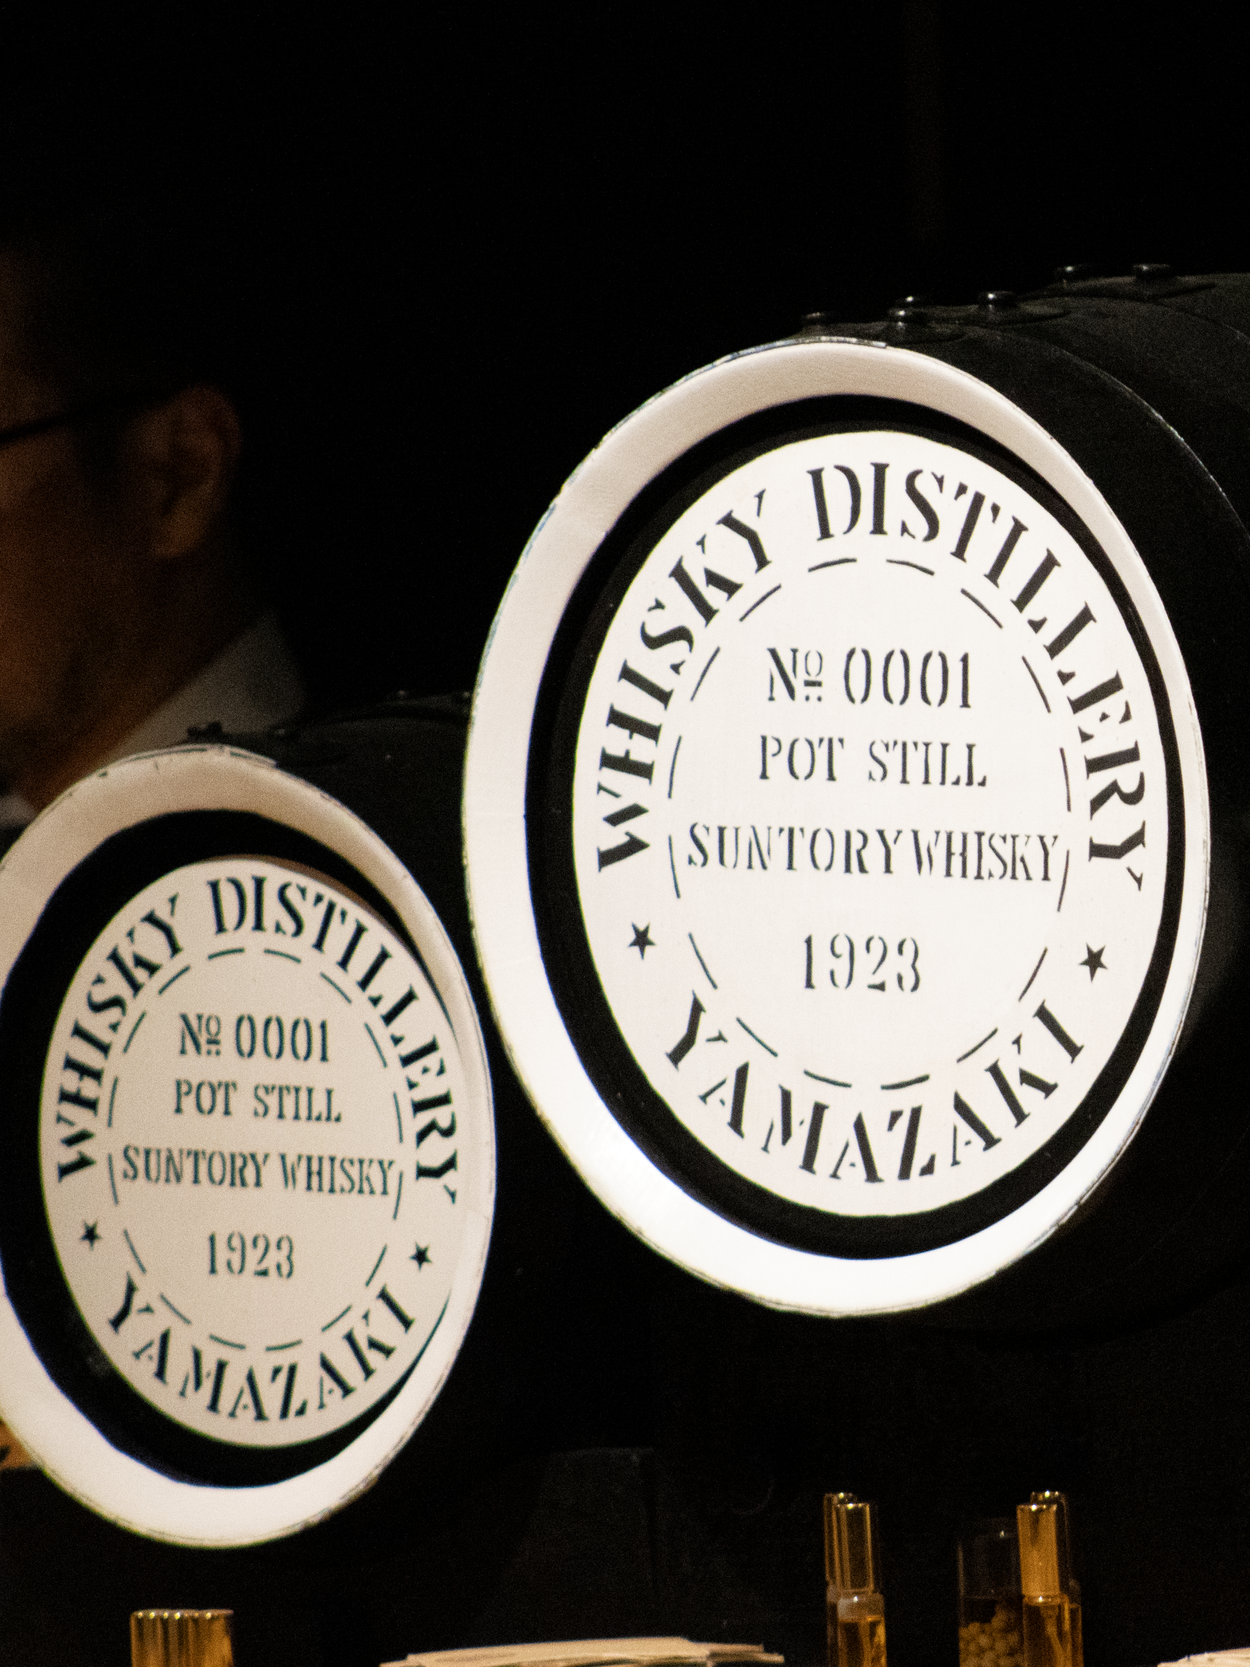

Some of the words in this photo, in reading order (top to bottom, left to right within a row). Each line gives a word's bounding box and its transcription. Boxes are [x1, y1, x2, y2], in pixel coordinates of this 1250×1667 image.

[595, 488, 773, 873] WHISKY
[805, 462, 1147, 891] DISTILLERY
[843, 647, 971, 709] 0001
[759, 735, 844, 782] POT
[868, 739, 987, 788] STILL
[687, 822, 903, 874] SUNTORY
[911, 829, 1058, 882] WHISKY
[804, 934, 921, 993] 1923
[57, 893, 185, 1182] WHISKY
[205, 876, 457, 1205] DISTILLERY
[234, 1014, 329, 1063] 0001
[173, 1079, 237, 1117] POT
[253, 1084, 342, 1123] STILL
[665, 990, 1085, 1184] YAMAZAKI
[122, 1144, 270, 1188] SUNTORY
[278, 1152, 395, 1196] WHISKY
[208, 1232, 294, 1279] 1923
[107, 1270, 417, 1422] YAMAZAKI
